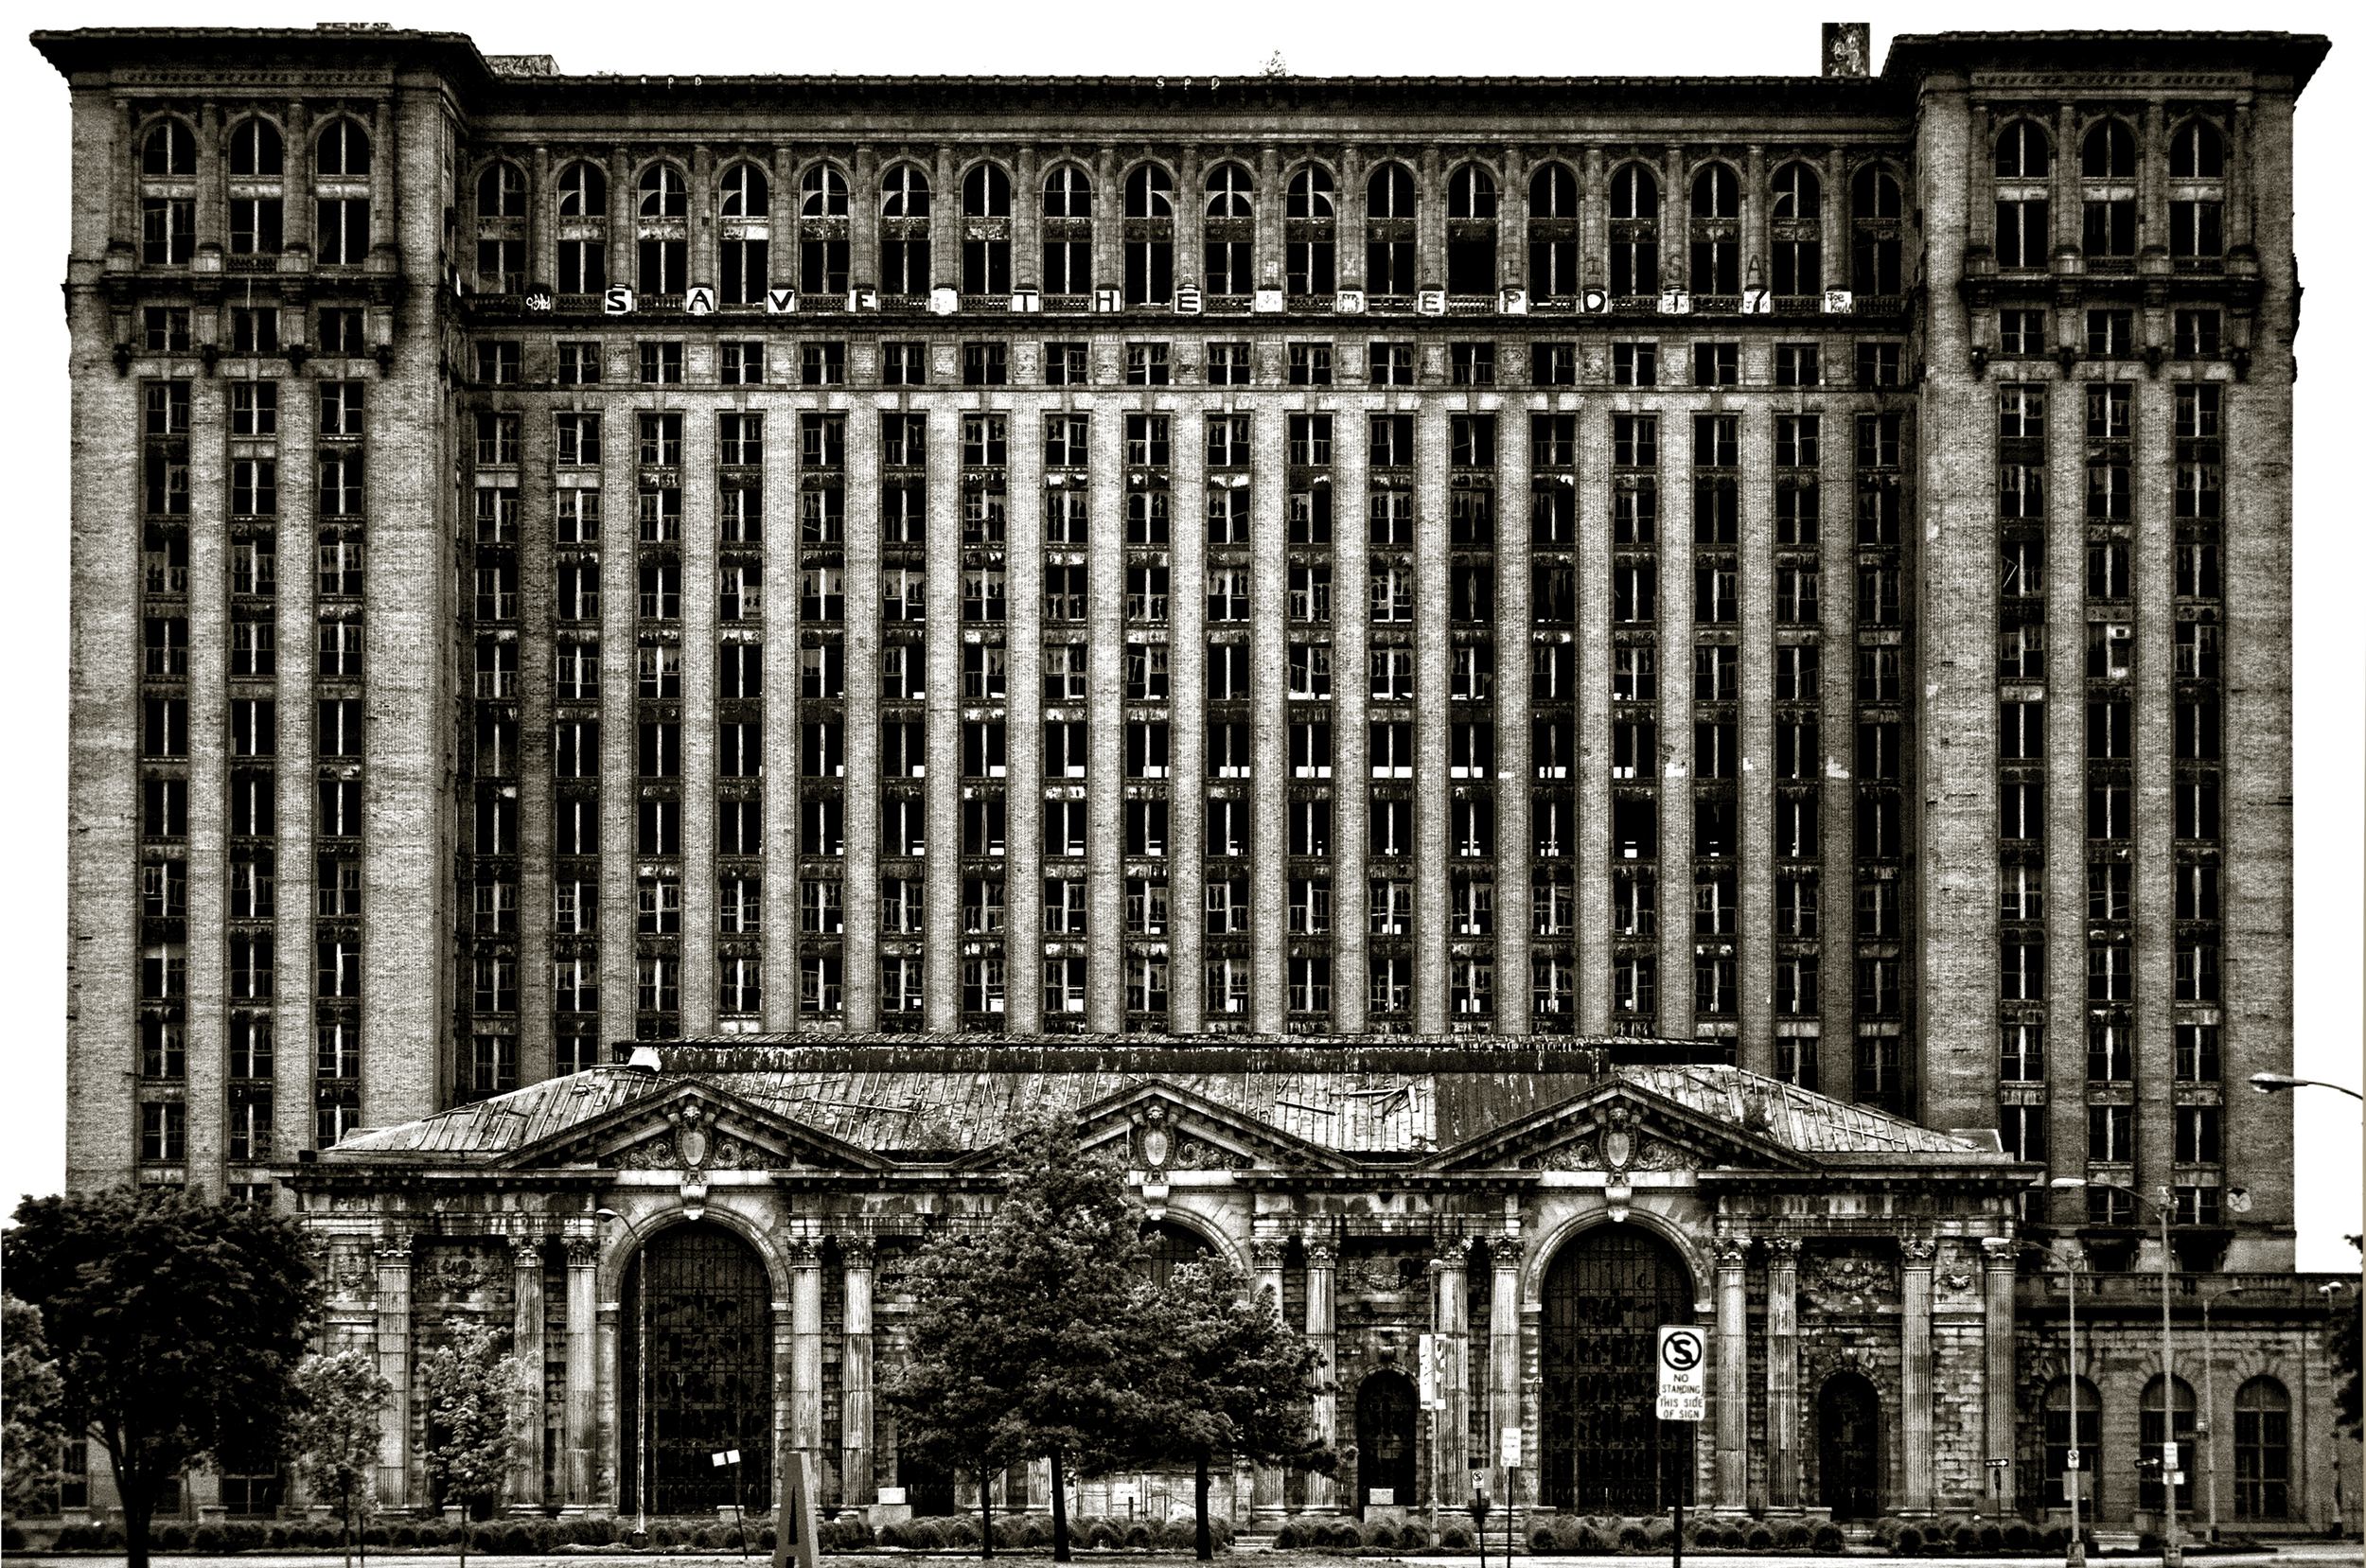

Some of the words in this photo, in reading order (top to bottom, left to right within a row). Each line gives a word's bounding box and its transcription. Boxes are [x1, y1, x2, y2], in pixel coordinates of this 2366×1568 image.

[1013, 291, 1199, 314] THE
[1673, 1374, 1688, 1383] NO
[1661, 1384, 1701, 1394] STANDING
[1660, 1397, 1679, 1408] THIS
[1683, 1397, 1703, 1408] SIDE
[1663, 1409, 1674, 1418] OF
[1679, 1409, 1700, 1418] SIGN
